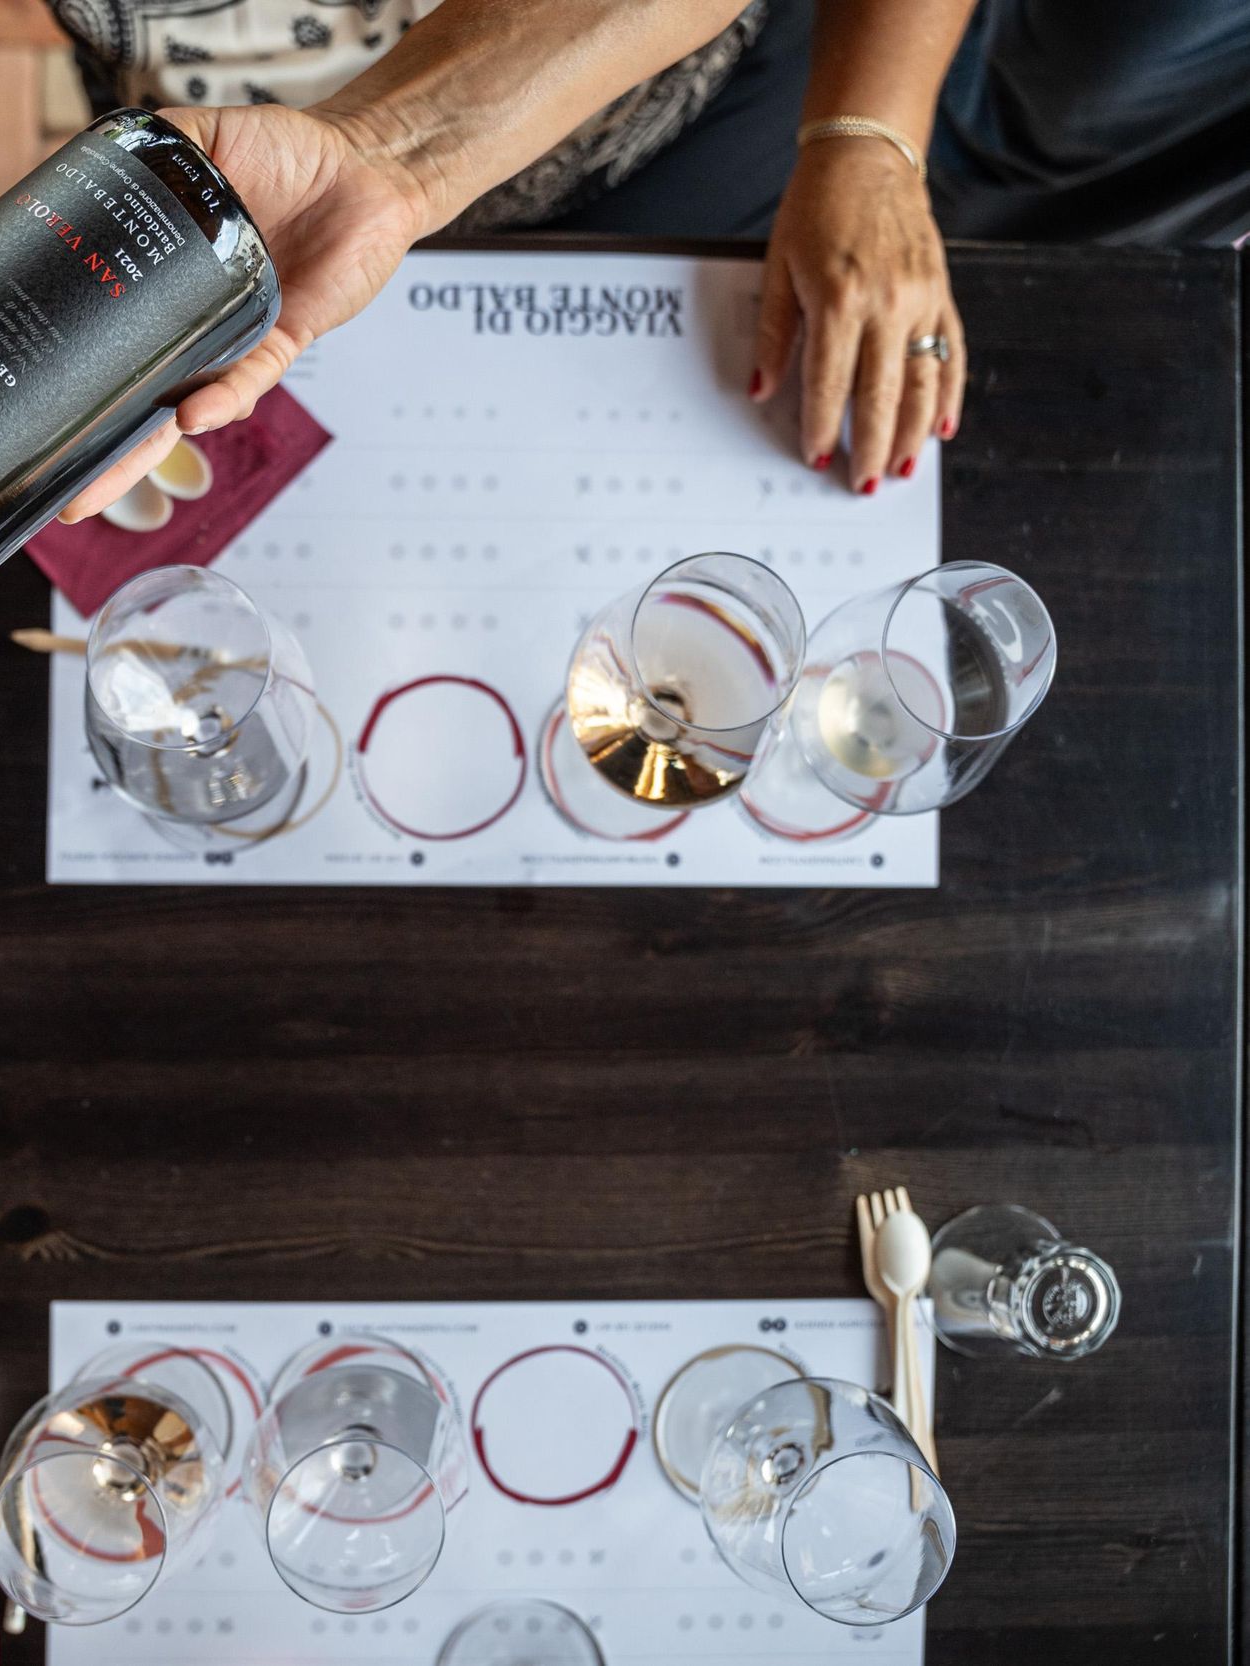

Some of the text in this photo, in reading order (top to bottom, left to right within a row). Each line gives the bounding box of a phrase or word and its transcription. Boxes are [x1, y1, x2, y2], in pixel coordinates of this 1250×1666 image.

[109, 162, 132, 184] Origine
[129, 182, 139, 192] di
[54, 161, 164, 265] MONTEBALDO
[121, 191, 176, 254] Bardolino
[136, 189, 186, 246] Denominazione
[13, 191, 127, 300] SAN VEROLO
[113, 247, 143, 282] 2021
[408, 282, 683, 314] MONTE BALDO
[472, 307, 684, 336] VIAGGIO DI
